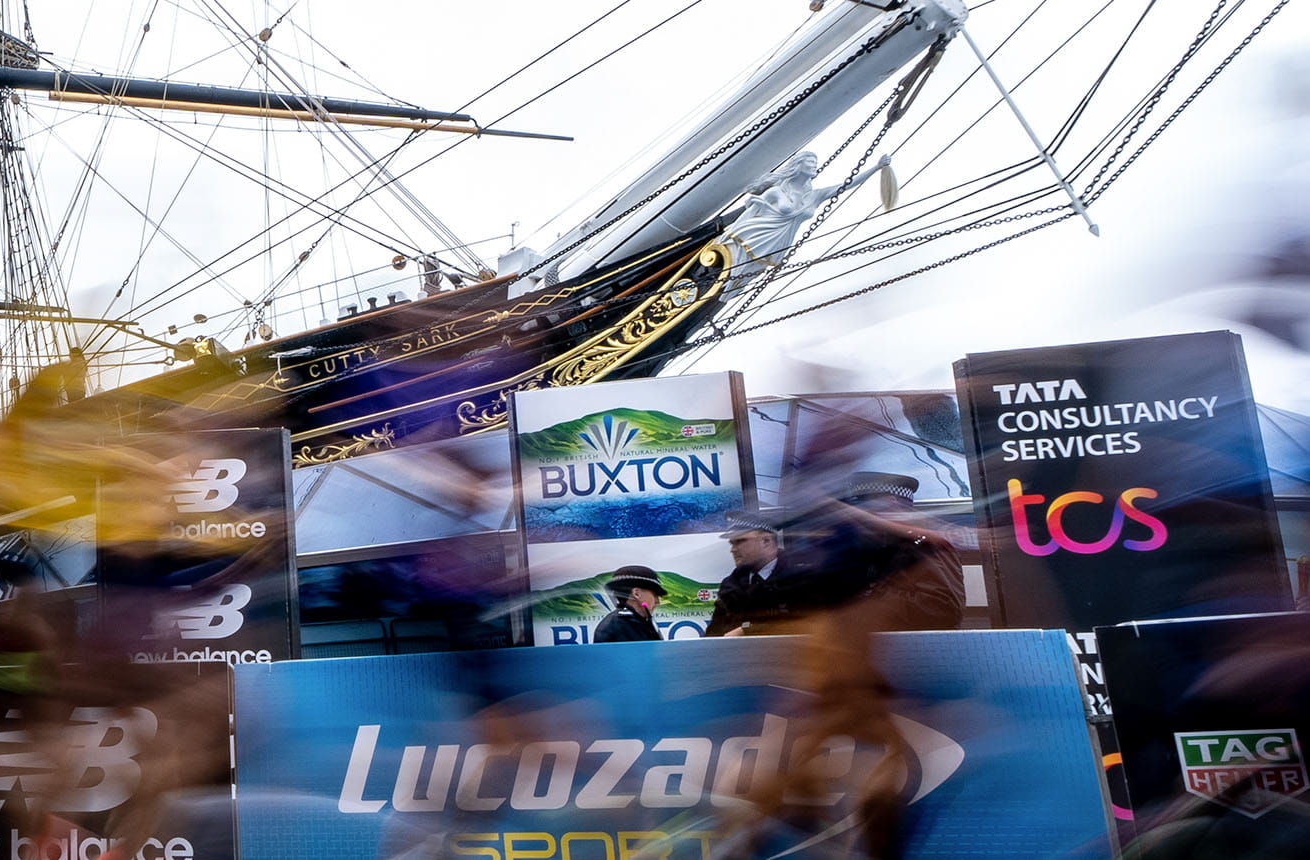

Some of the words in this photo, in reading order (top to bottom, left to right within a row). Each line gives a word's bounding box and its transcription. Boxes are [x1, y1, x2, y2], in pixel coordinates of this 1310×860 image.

[308, 346, 380, 378] CUTTY
[401, 323, 462, 351] SARK
[993, 378, 1087, 405] TATA
[997, 395, 1218, 433] CONSULTANCY
[564, 453, 599, 462] BRITISH
[619, 448, 653, 457] NATURAL
[656, 446, 690, 454] MINERAL
[691, 443, 717, 451] WATER
[1001, 431, 1141, 462] SERVICES
[538, 453, 721, 499] BUXTON
[169, 519, 266, 539] balance
[1007, 478, 1169, 556] tcs
[671, 610, 705, 618] MINERAL
[173, 646, 272, 664] balance
[336, 712, 857, 815] Lucozade
[1186, 736, 1291, 763] TAG
